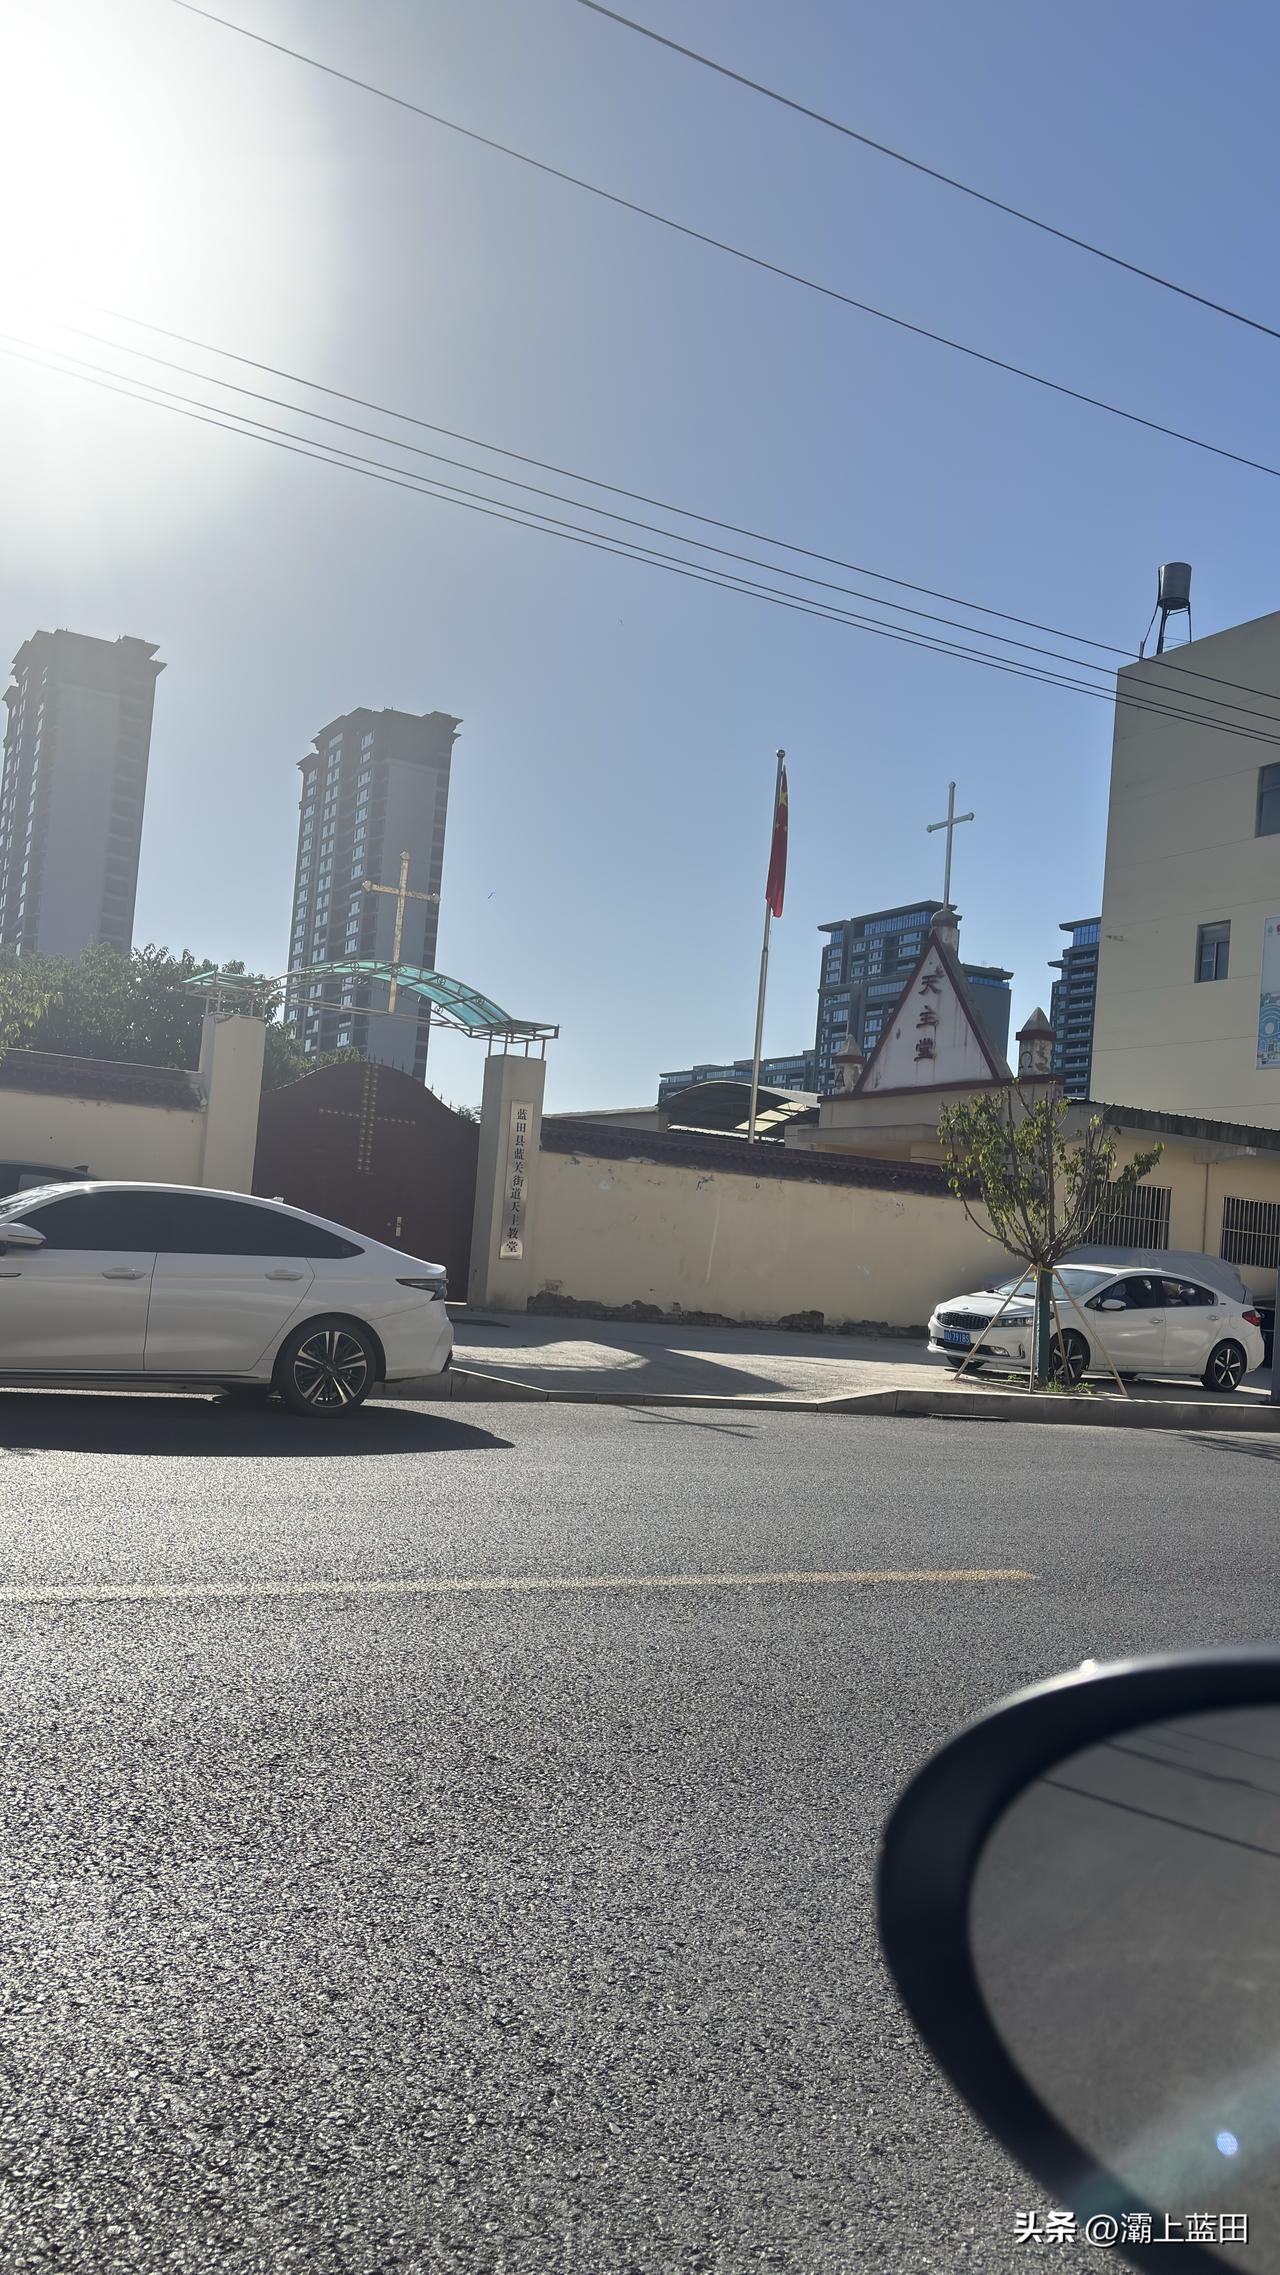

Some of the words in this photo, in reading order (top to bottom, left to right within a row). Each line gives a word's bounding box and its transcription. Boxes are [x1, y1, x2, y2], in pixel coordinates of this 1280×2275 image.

[913, 974, 942, 1062] 天主堂
[506, 1108, 528, 1253] 蓝田县蓝关街道天主教堂
